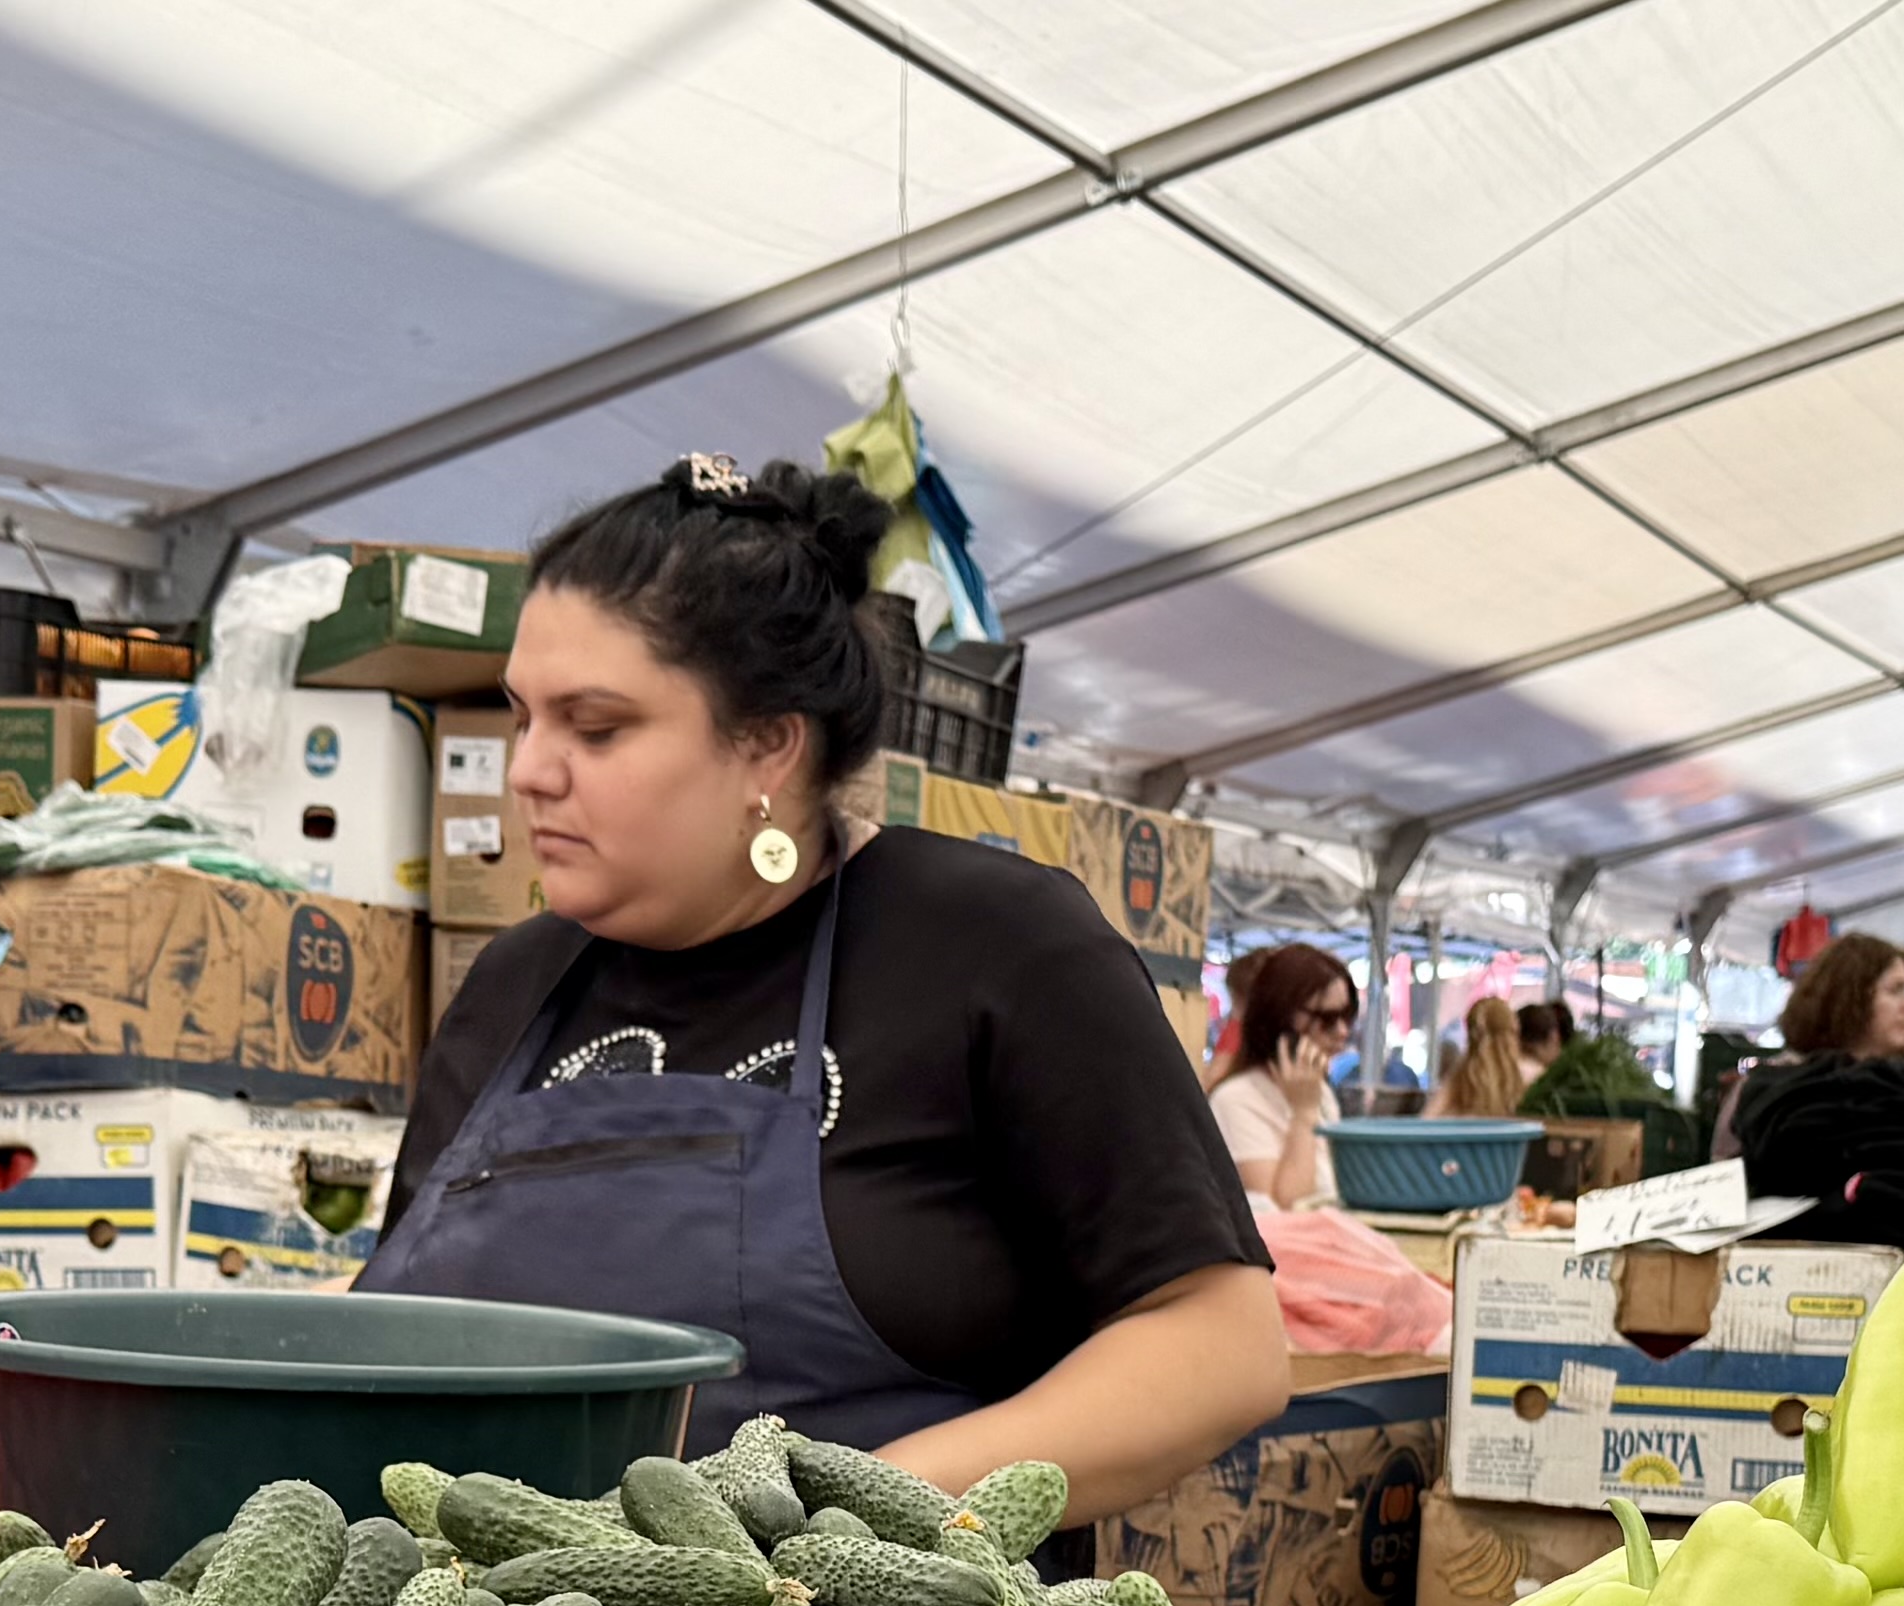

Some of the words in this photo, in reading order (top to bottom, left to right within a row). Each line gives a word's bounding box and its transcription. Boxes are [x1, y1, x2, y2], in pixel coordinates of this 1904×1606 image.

[298, 934, 344, 973] SCB
[26, 1102, 82, 1121] PACK
[1602, 1427, 1704, 1479] BONITA
